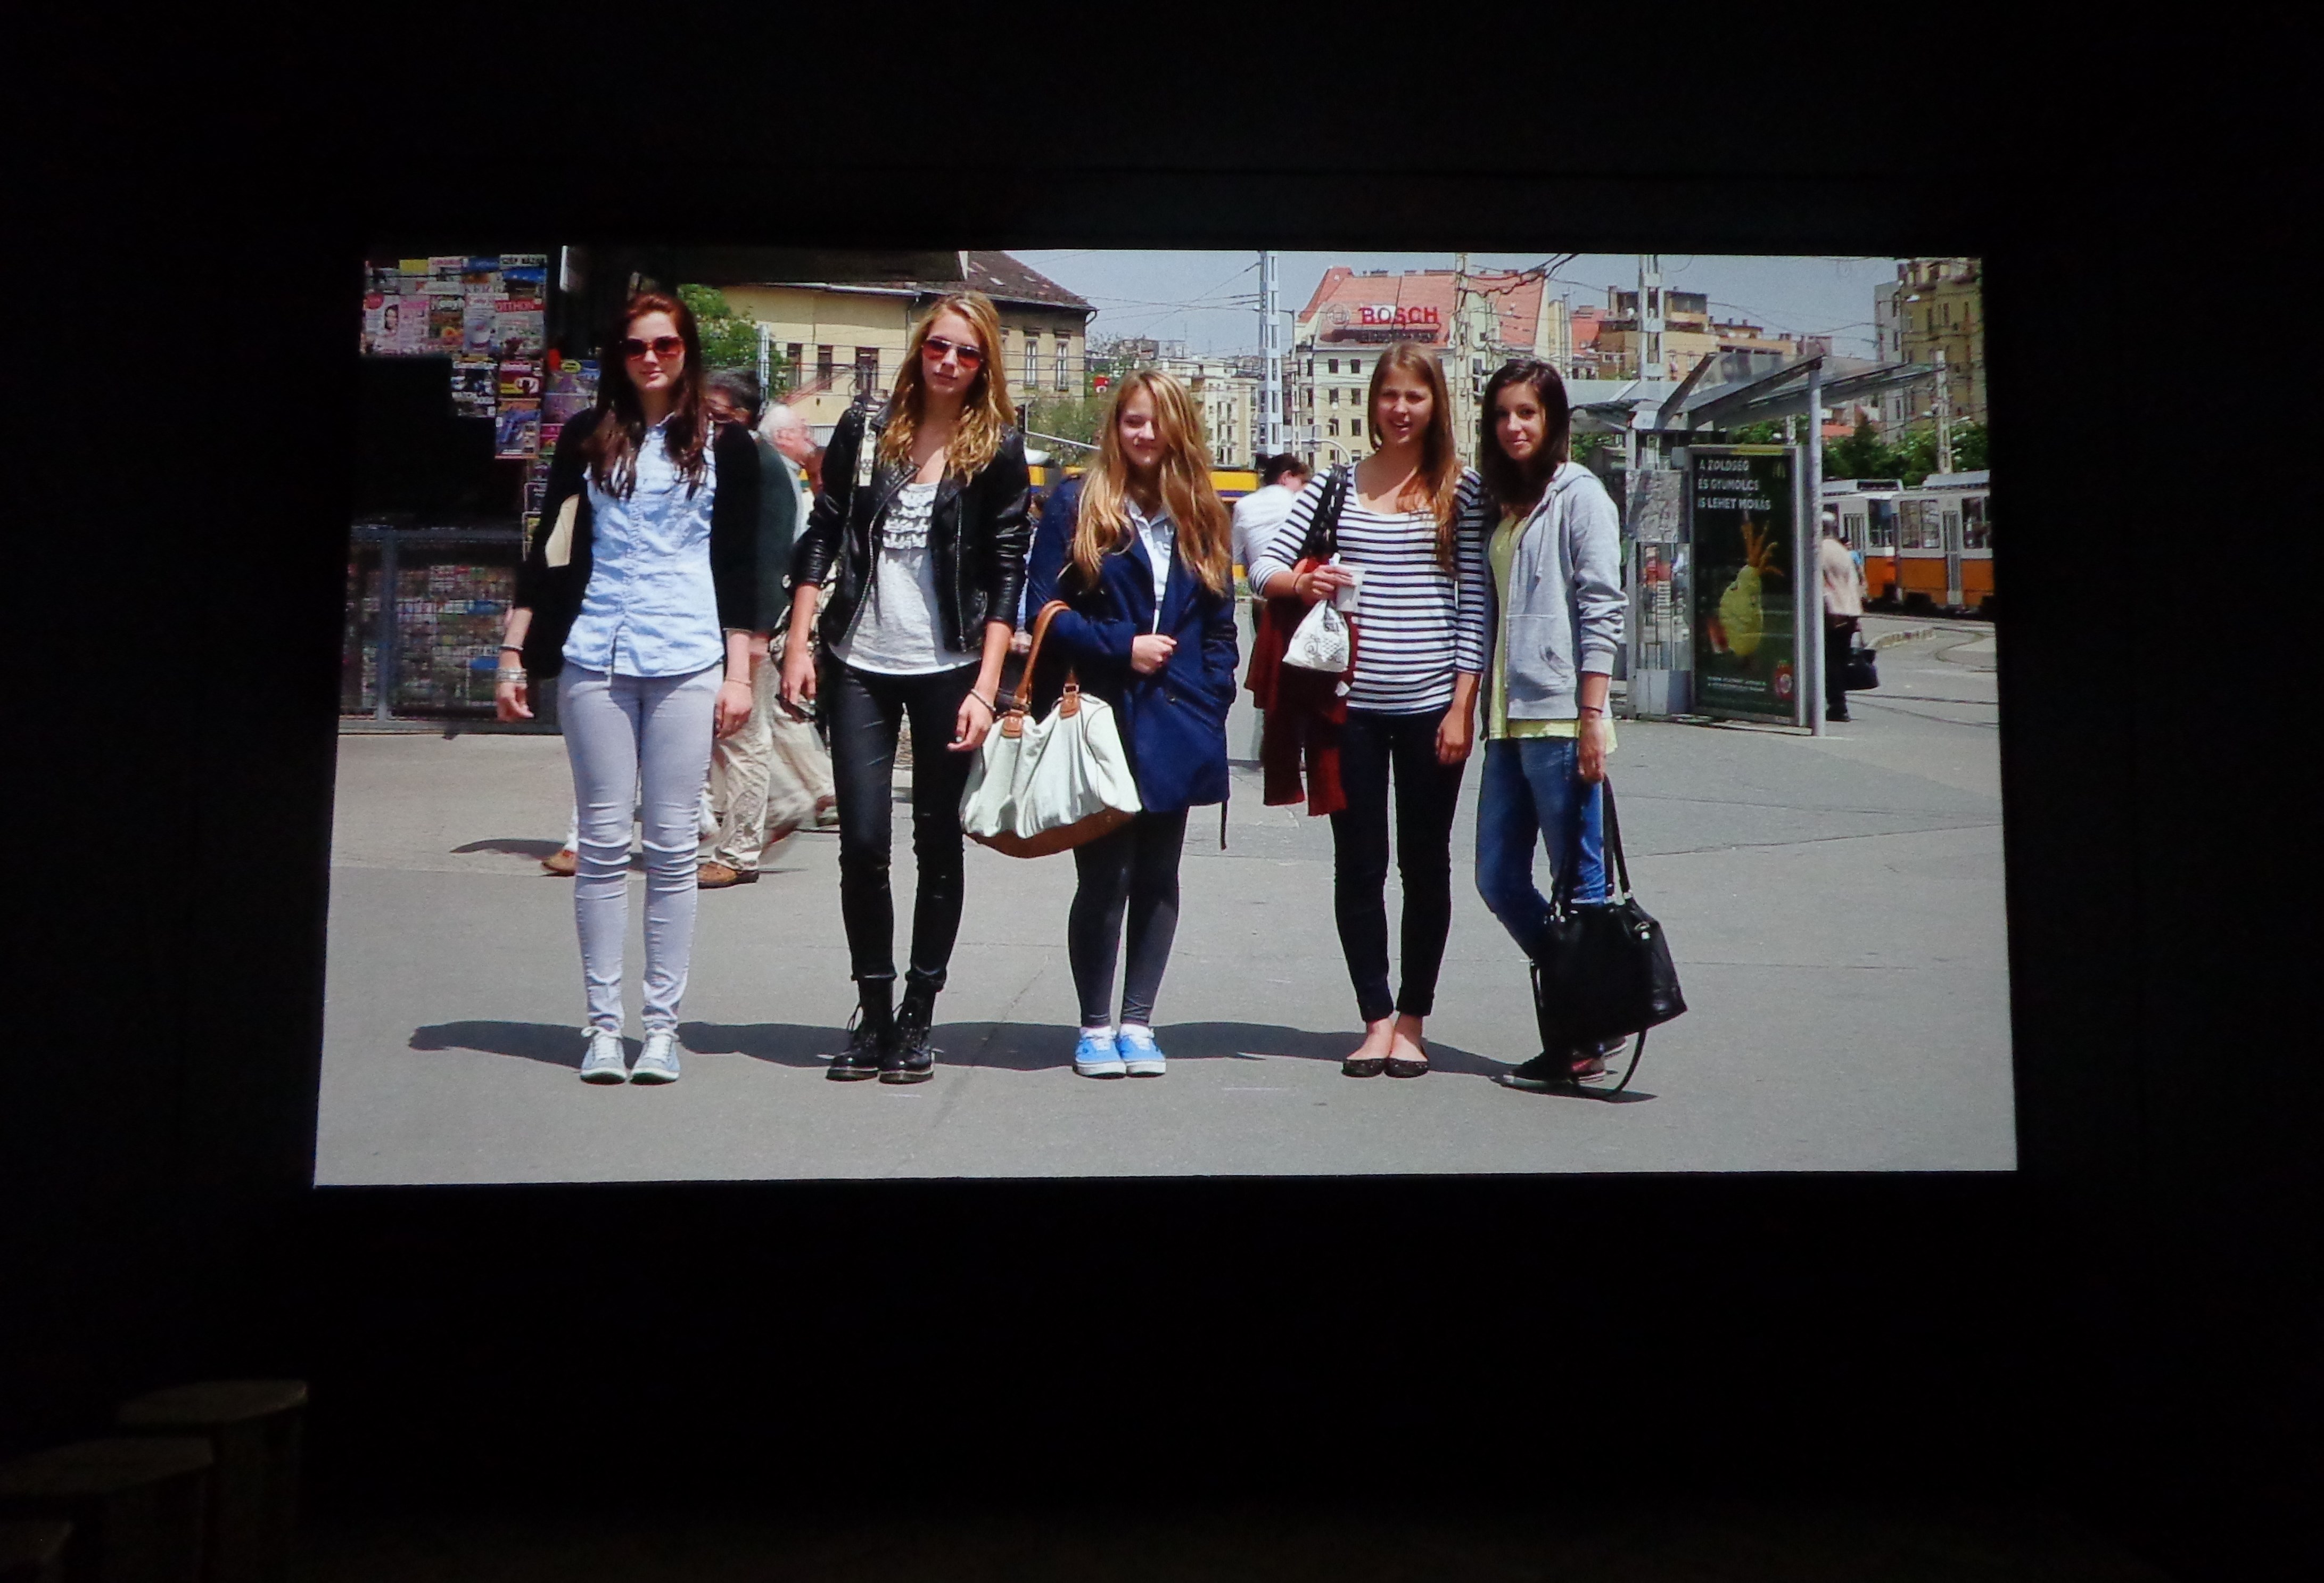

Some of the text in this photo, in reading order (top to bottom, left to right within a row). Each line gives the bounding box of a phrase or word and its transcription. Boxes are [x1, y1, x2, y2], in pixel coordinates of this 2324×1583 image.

[1360, 307, 1438, 324] BOSCH
[1699, 459, 1705, 471] A
[1707, 497, 1737, 509] LEHET
